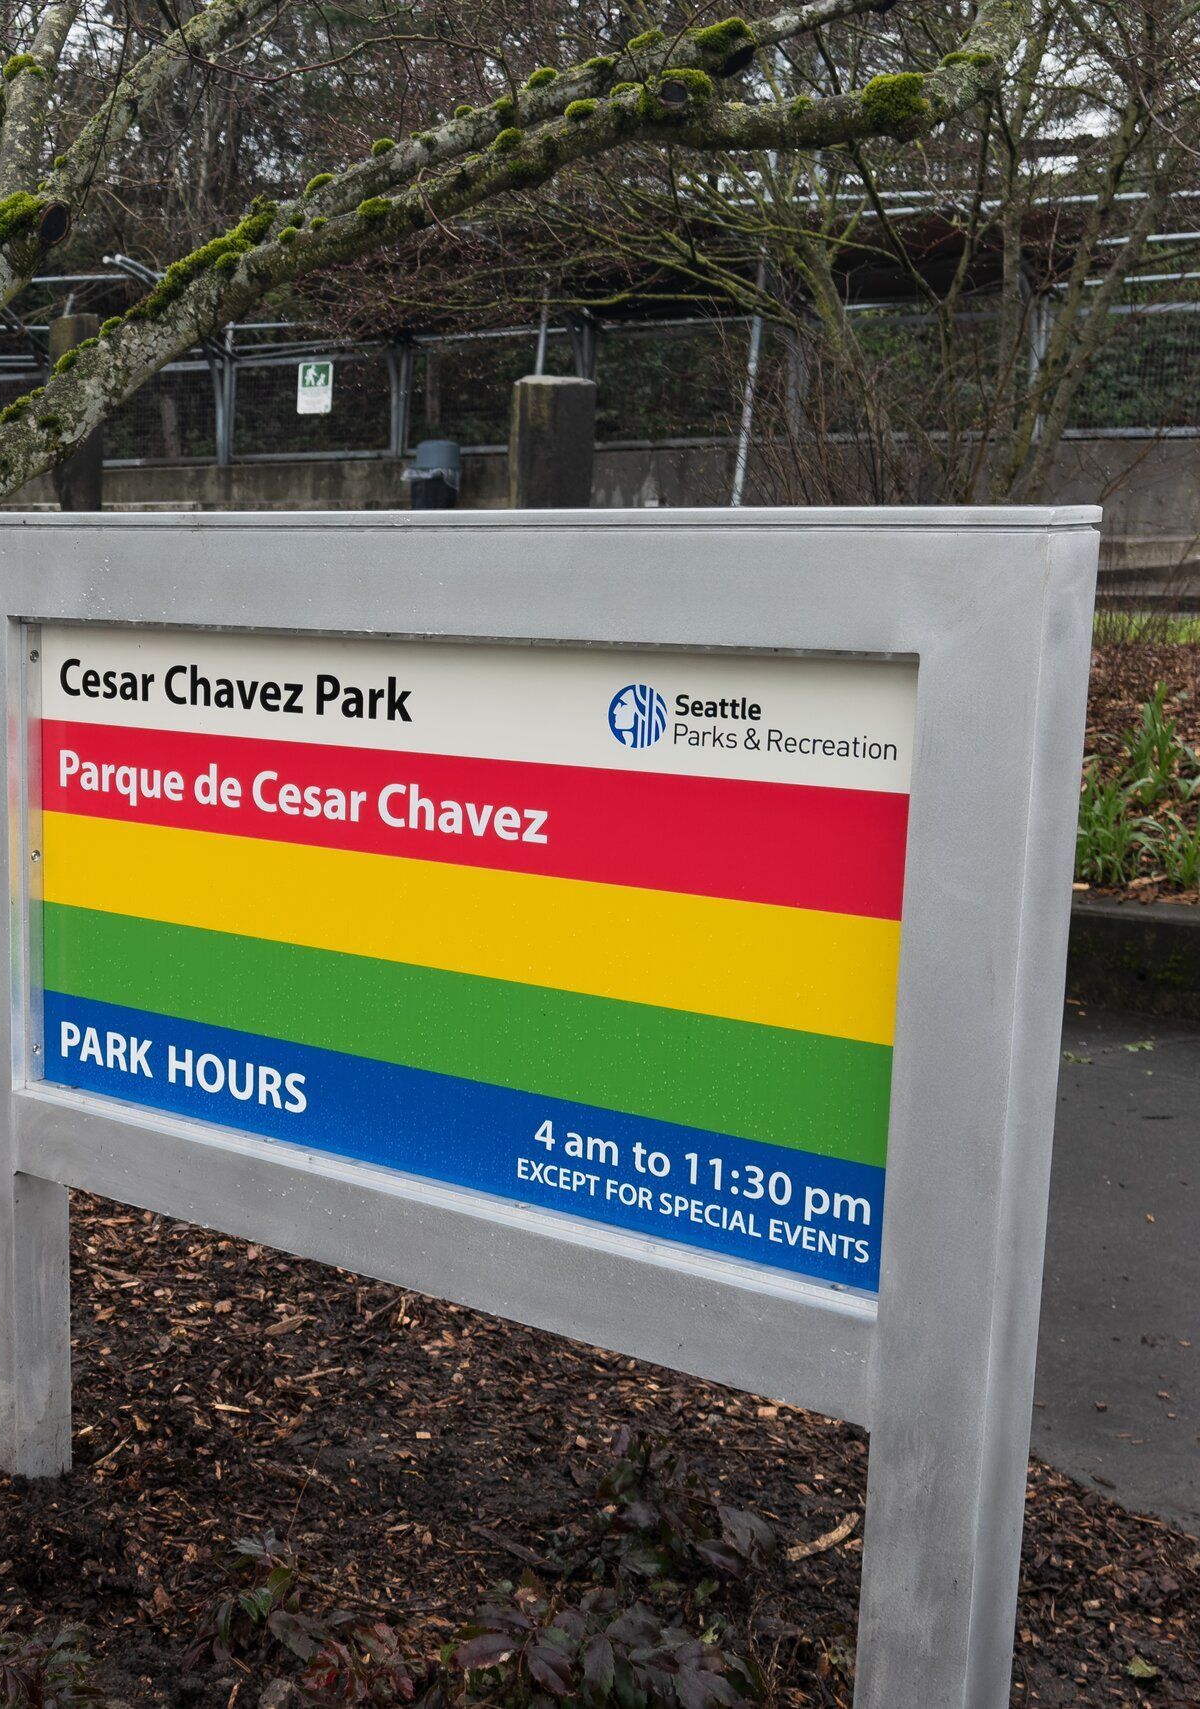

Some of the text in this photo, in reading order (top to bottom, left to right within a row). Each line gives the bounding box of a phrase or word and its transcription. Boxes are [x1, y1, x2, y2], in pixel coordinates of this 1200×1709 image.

[60, 658, 412, 722] Cesar Chavez Park
[675, 694, 761, 720] Seattle
[674, 723, 897, 761] Parks & Recreation
[59, 749, 548, 844] Parque de Cesar Chavez
[61, 1021, 307, 1114] PARK HOURS
[517, 1157, 870, 1264] EXCEPT FOR SPECIAL EVENTS
[534, 1120, 871, 1225] 4 am to 11:30 pm
